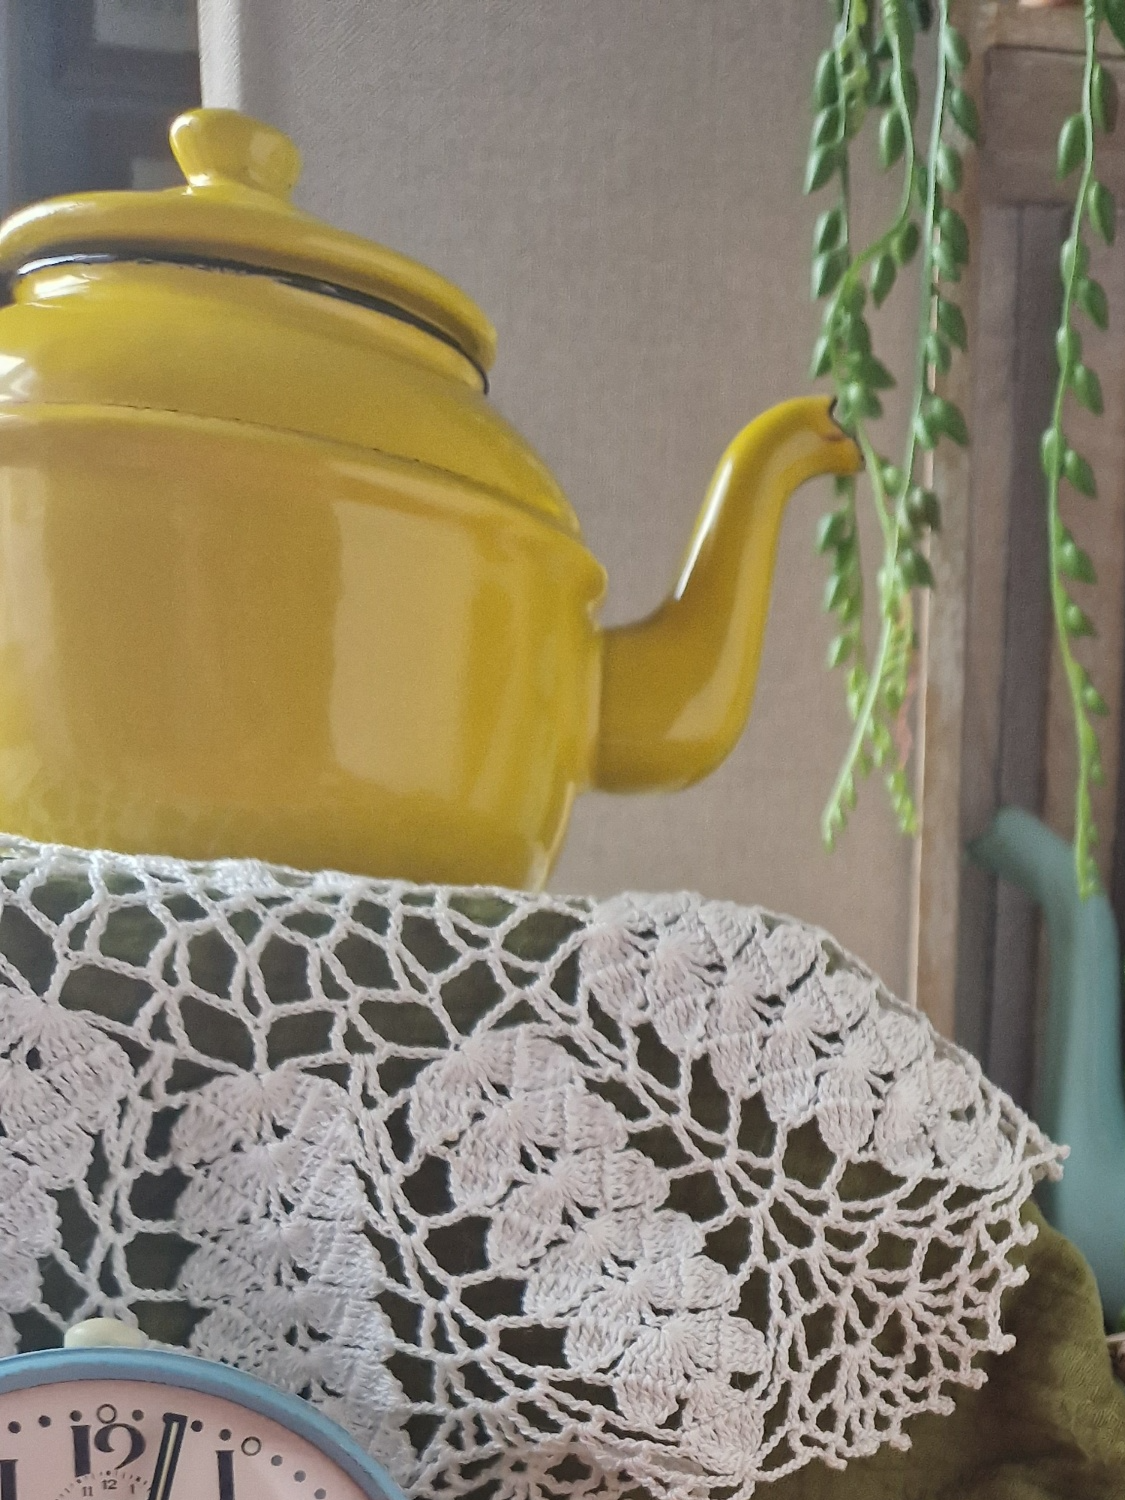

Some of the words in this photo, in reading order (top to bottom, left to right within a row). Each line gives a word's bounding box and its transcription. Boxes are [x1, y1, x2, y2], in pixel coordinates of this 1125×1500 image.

[70, 1422, 146, 1478] 12
[101, 1479, 117, 1490] 12
[129, 1484, 136, 1494] 1
[82, 1486, 94, 1497] 11
